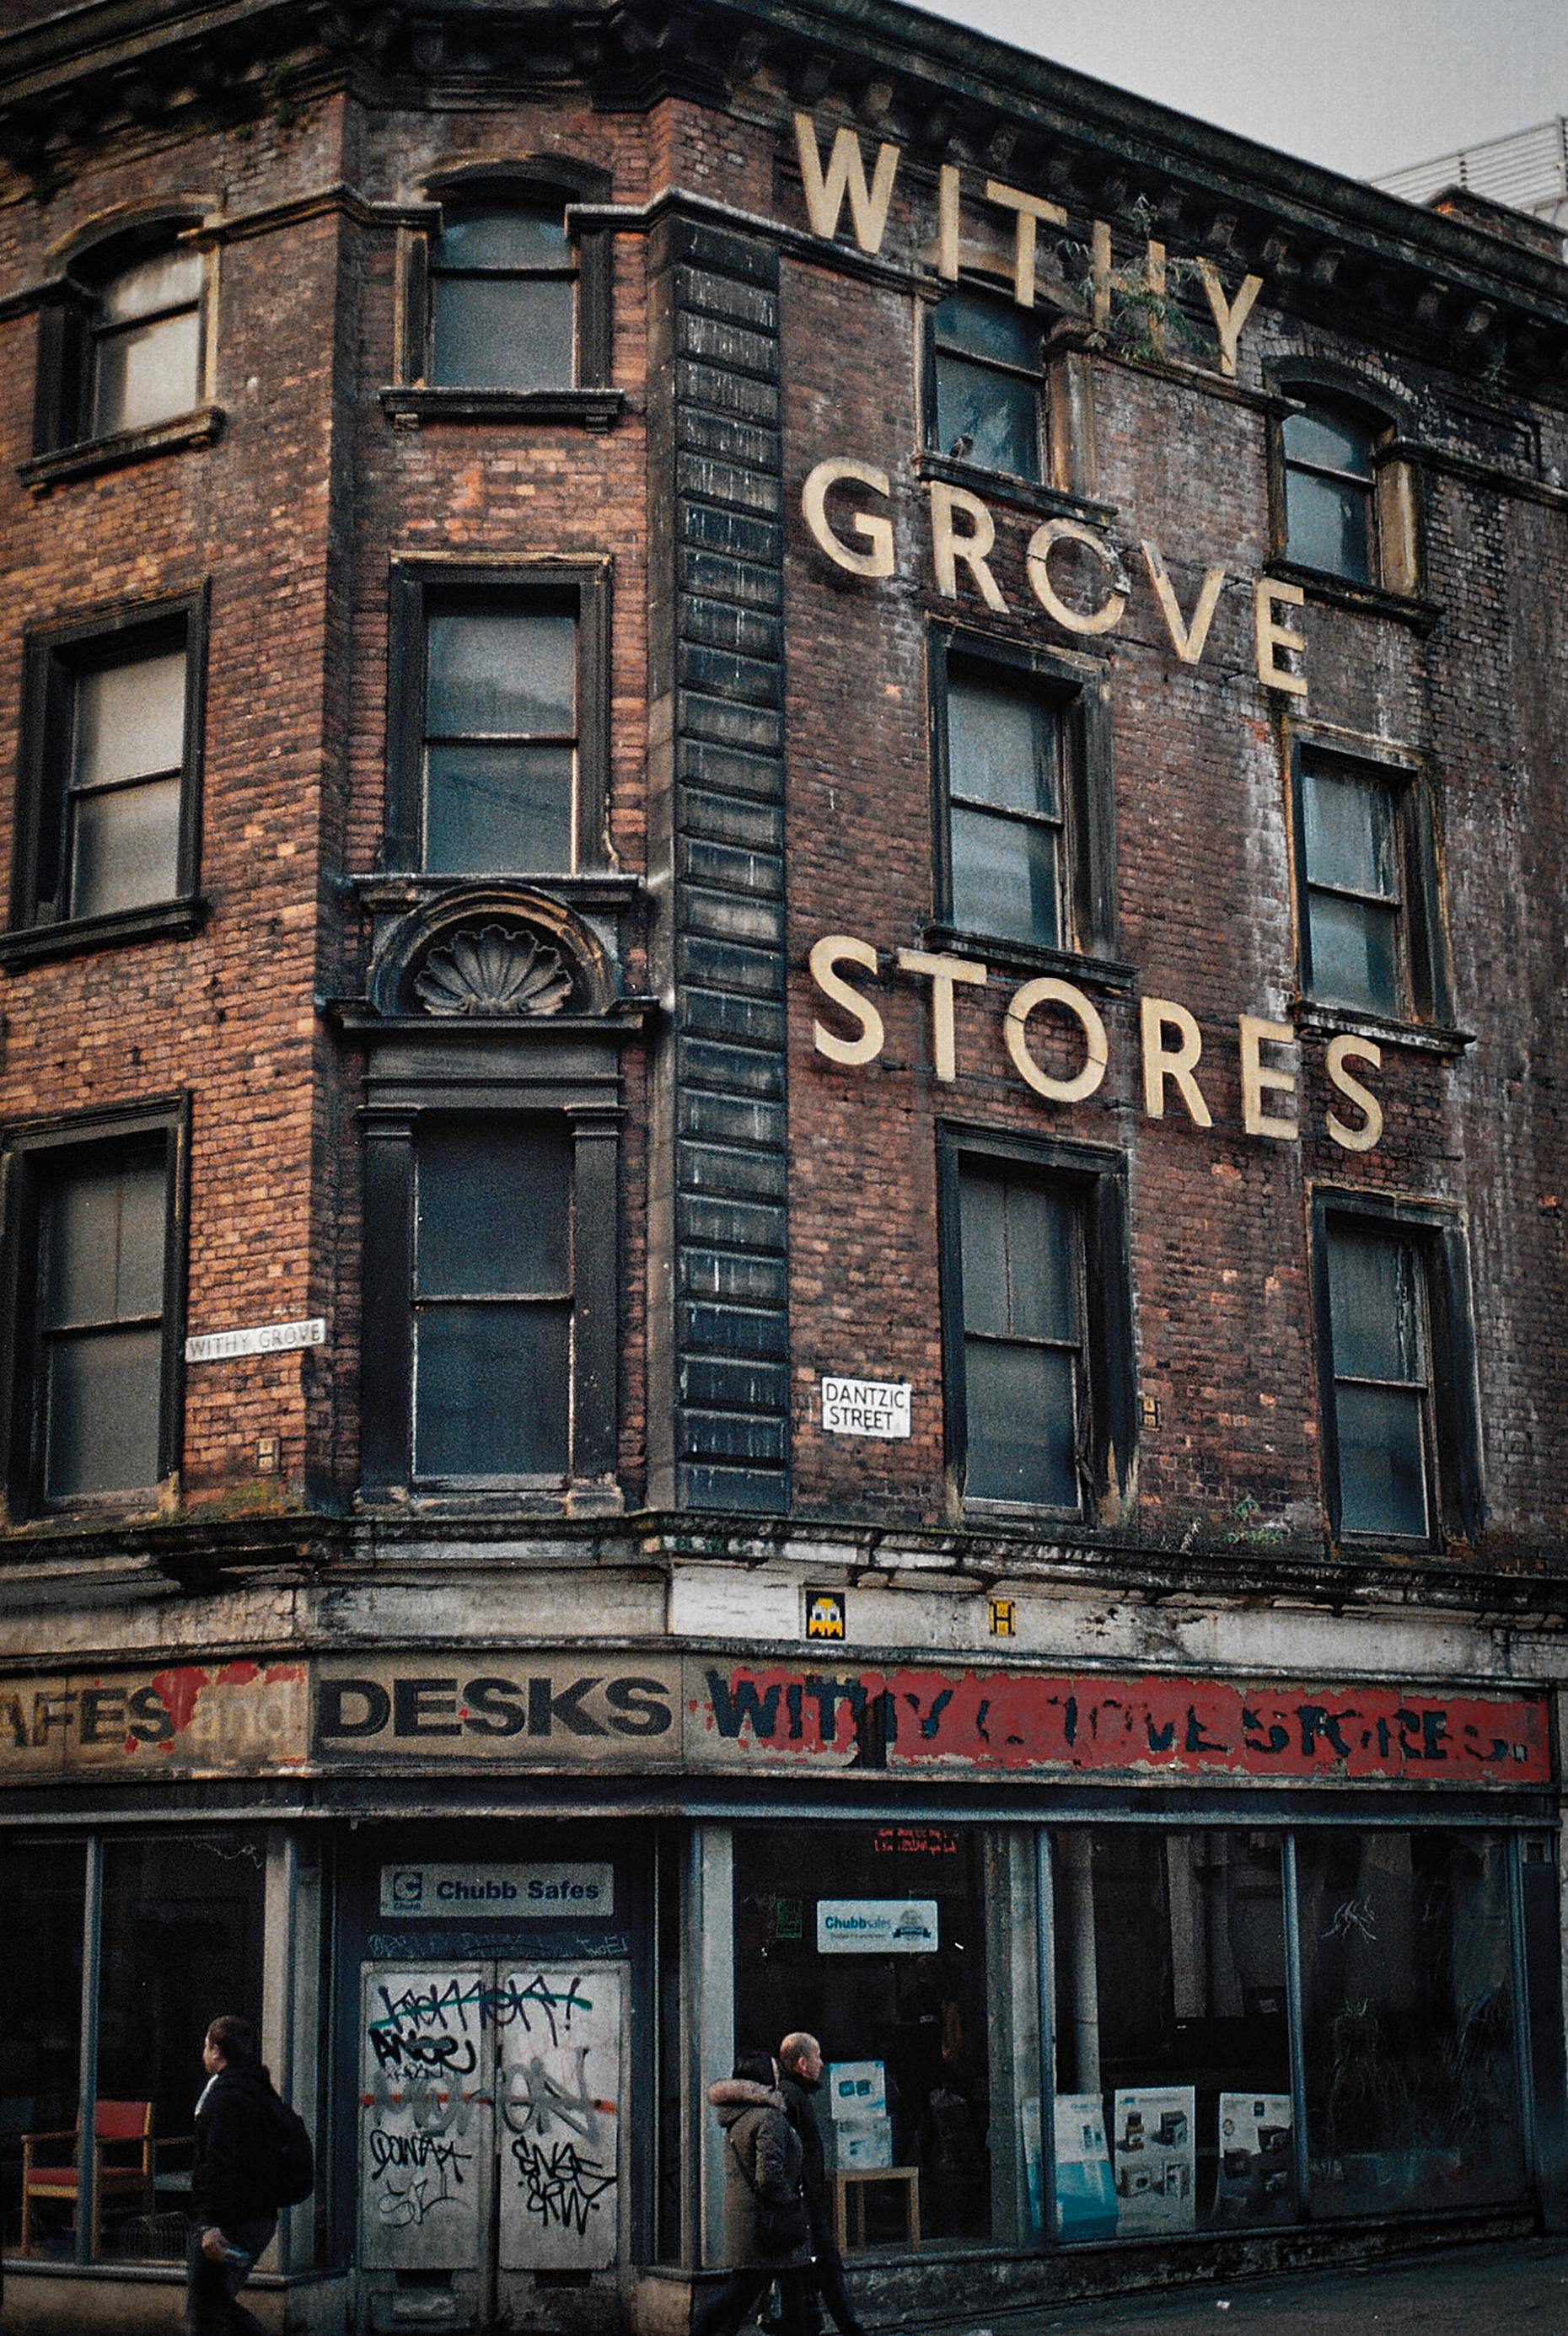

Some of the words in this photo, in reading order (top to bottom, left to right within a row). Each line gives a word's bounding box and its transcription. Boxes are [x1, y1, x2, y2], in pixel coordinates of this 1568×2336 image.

[793, 112, 1264, 377] WITHY
[802, 456, 1308, 696] GROVE
[809, 935, 1385, 1152] STORES
[190, 1335, 250, 1357] WITHY
[259, 1323, 320, 1349] GROVE
[826, 1383, 905, 1409] DANTZIC
[830, 1405, 893, 1431] STREET
[322, 1678, 672, 1738] DESKS
[437, 1880, 518, 1900] Chubb
[528, 1880, 599, 1900] Safes
